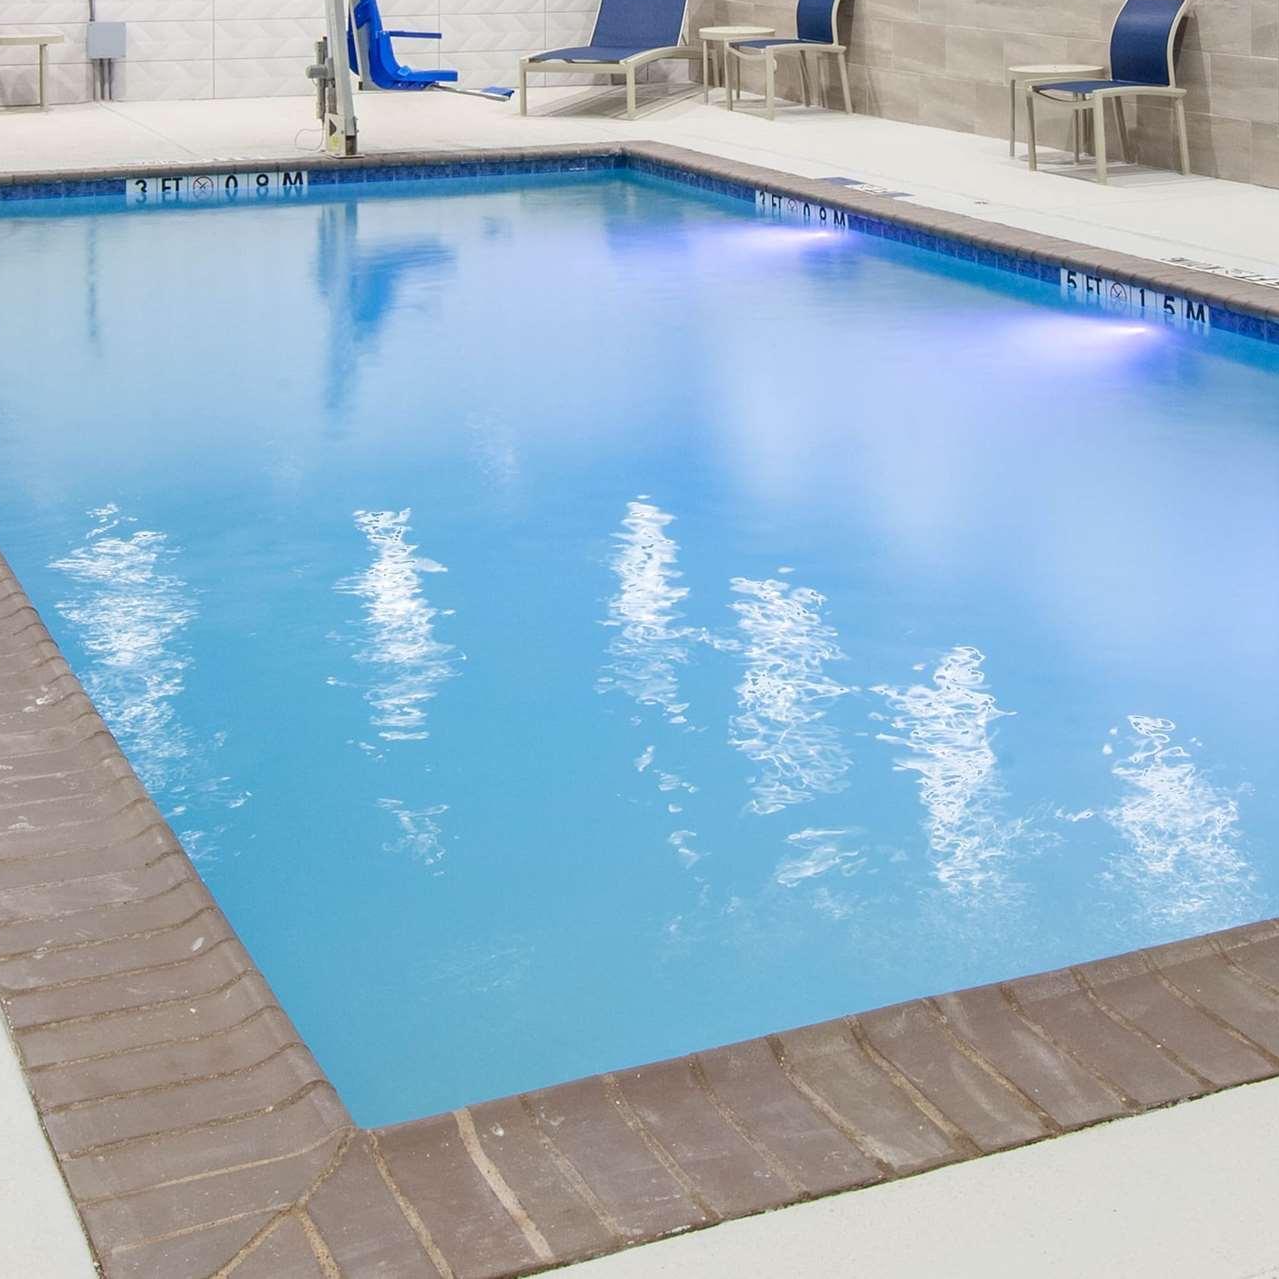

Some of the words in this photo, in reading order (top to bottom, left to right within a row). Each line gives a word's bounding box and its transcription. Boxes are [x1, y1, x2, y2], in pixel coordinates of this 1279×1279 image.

[161, 177, 184, 193] FT
[282, 172, 303, 186] M
[1086, 276, 1102, 296] FT
[1186, 300, 1206, 323] M
